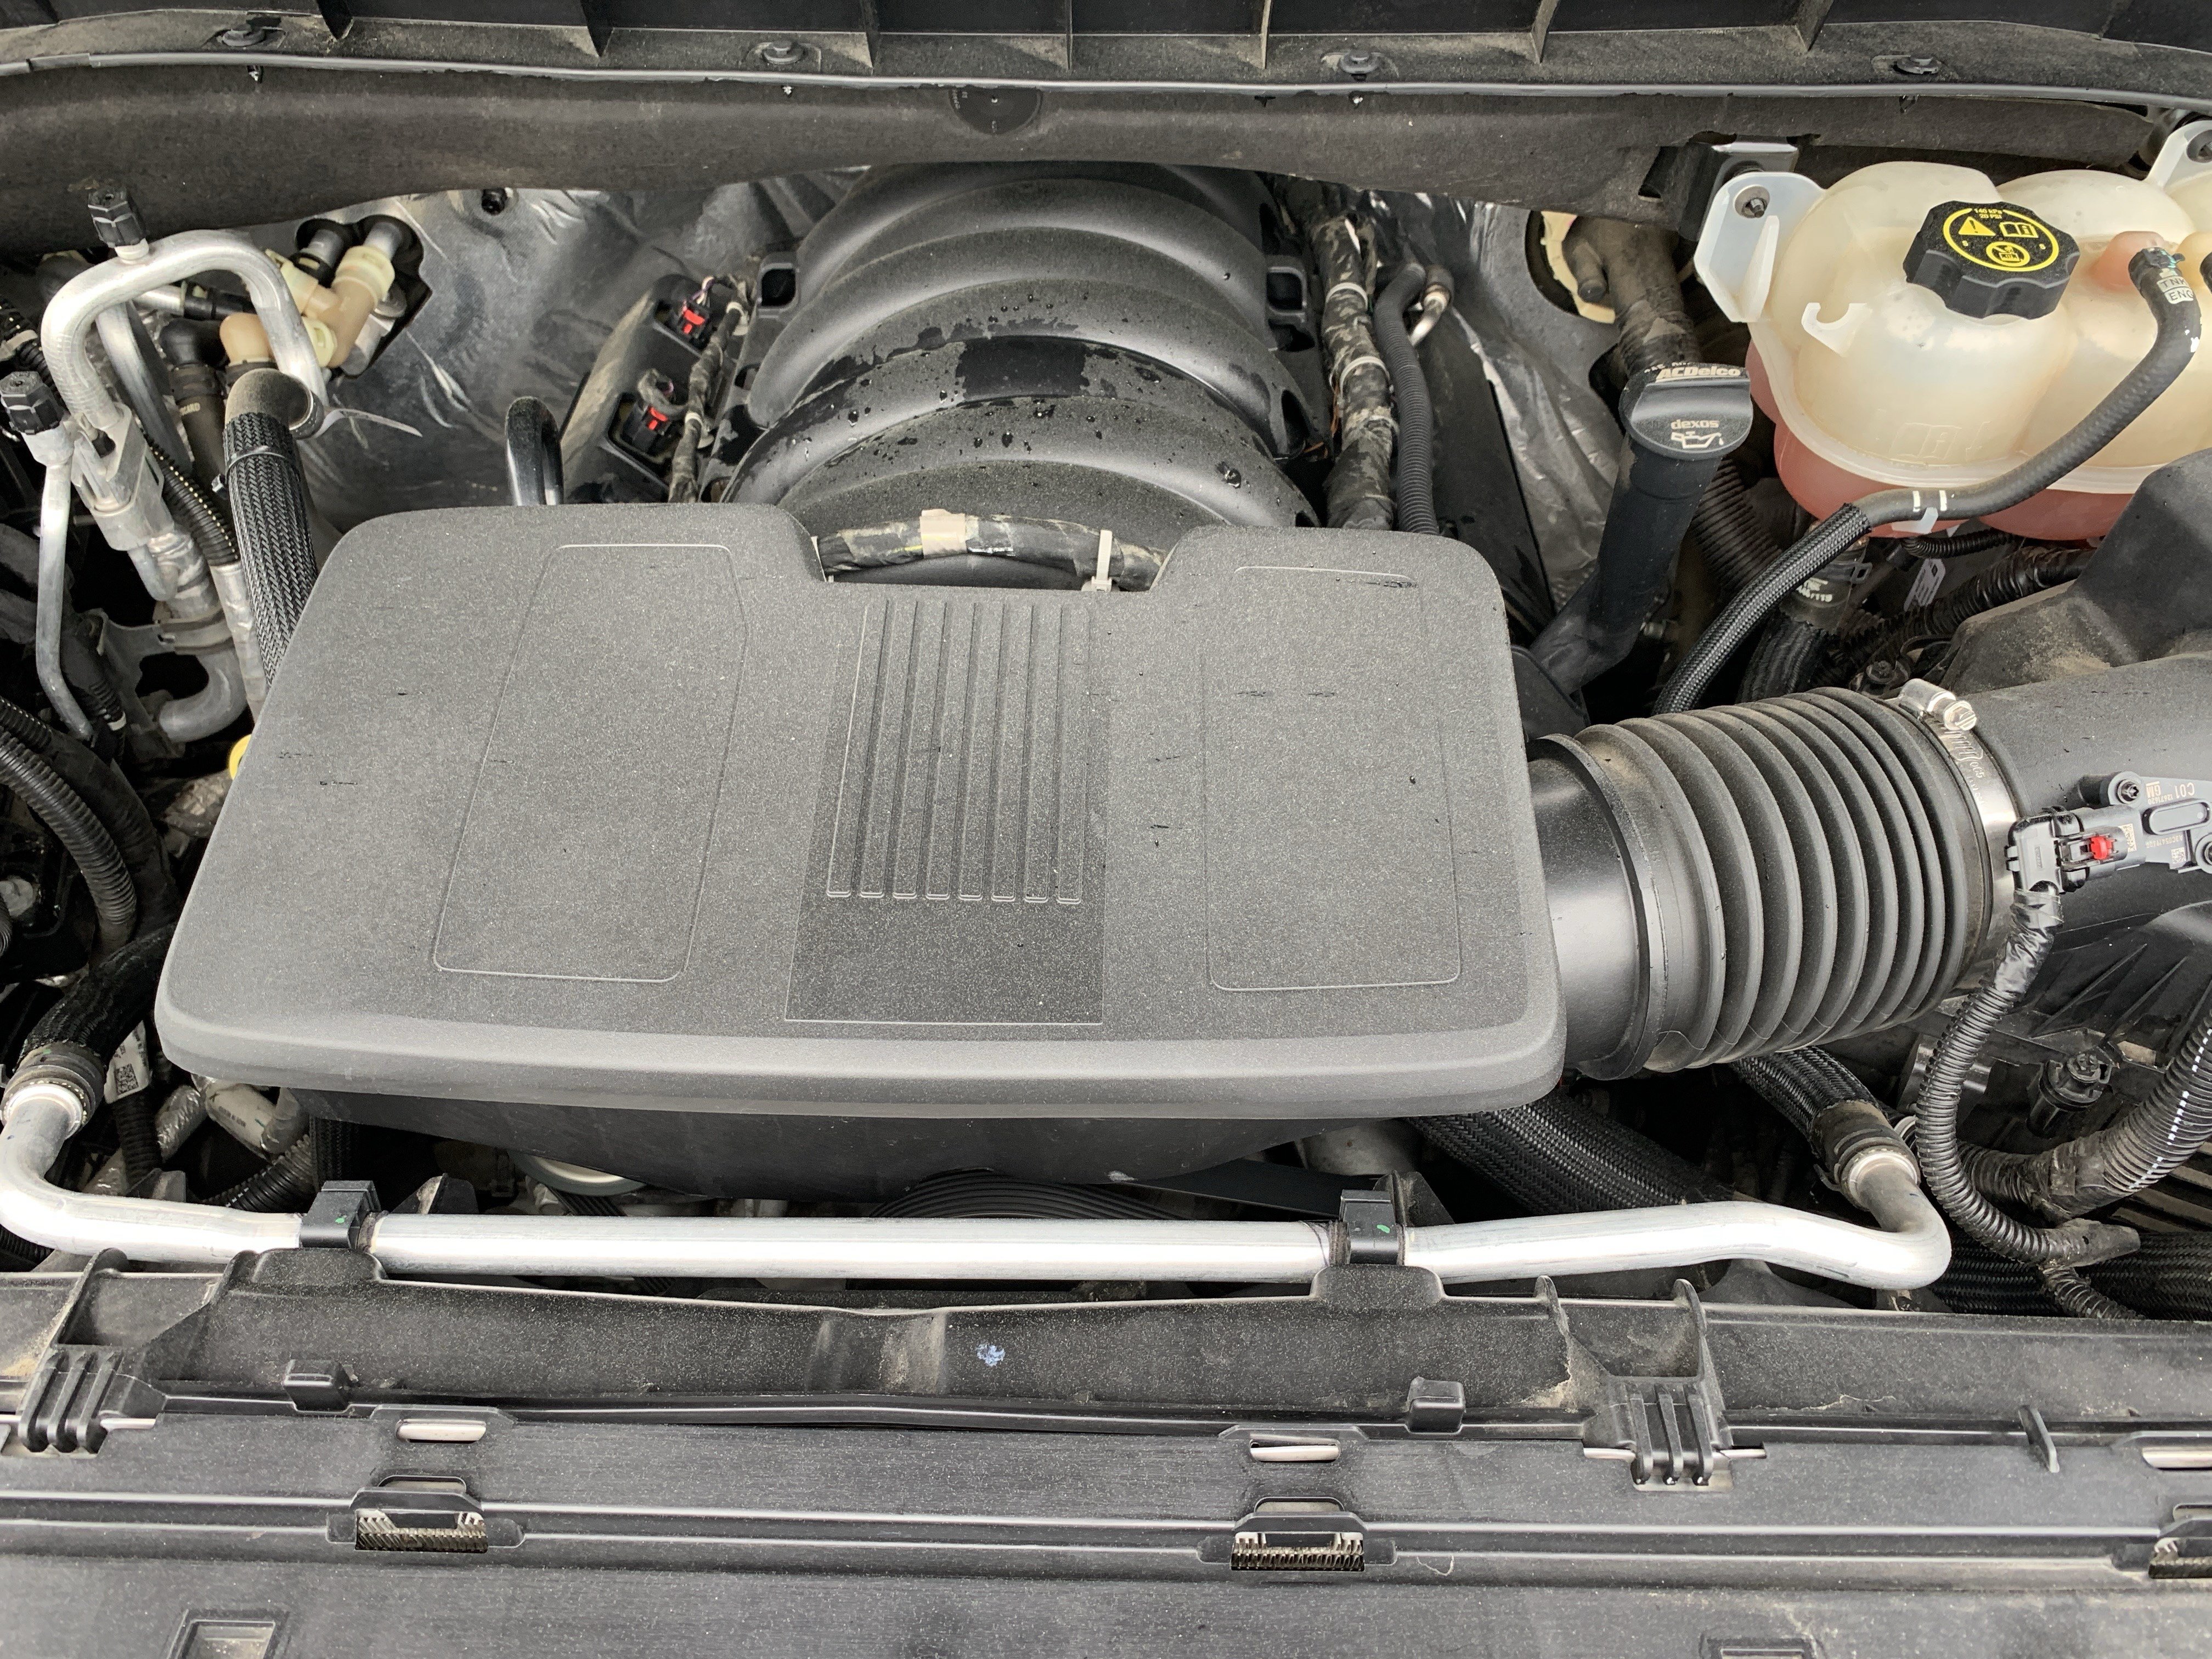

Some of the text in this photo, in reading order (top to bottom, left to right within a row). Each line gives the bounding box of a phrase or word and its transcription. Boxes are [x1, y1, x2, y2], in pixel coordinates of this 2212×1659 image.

[1655, 366, 1741, 380] ACDelco
[1671, 419, 1720, 430] dexos
[2146, 781, 2161, 798] GM
